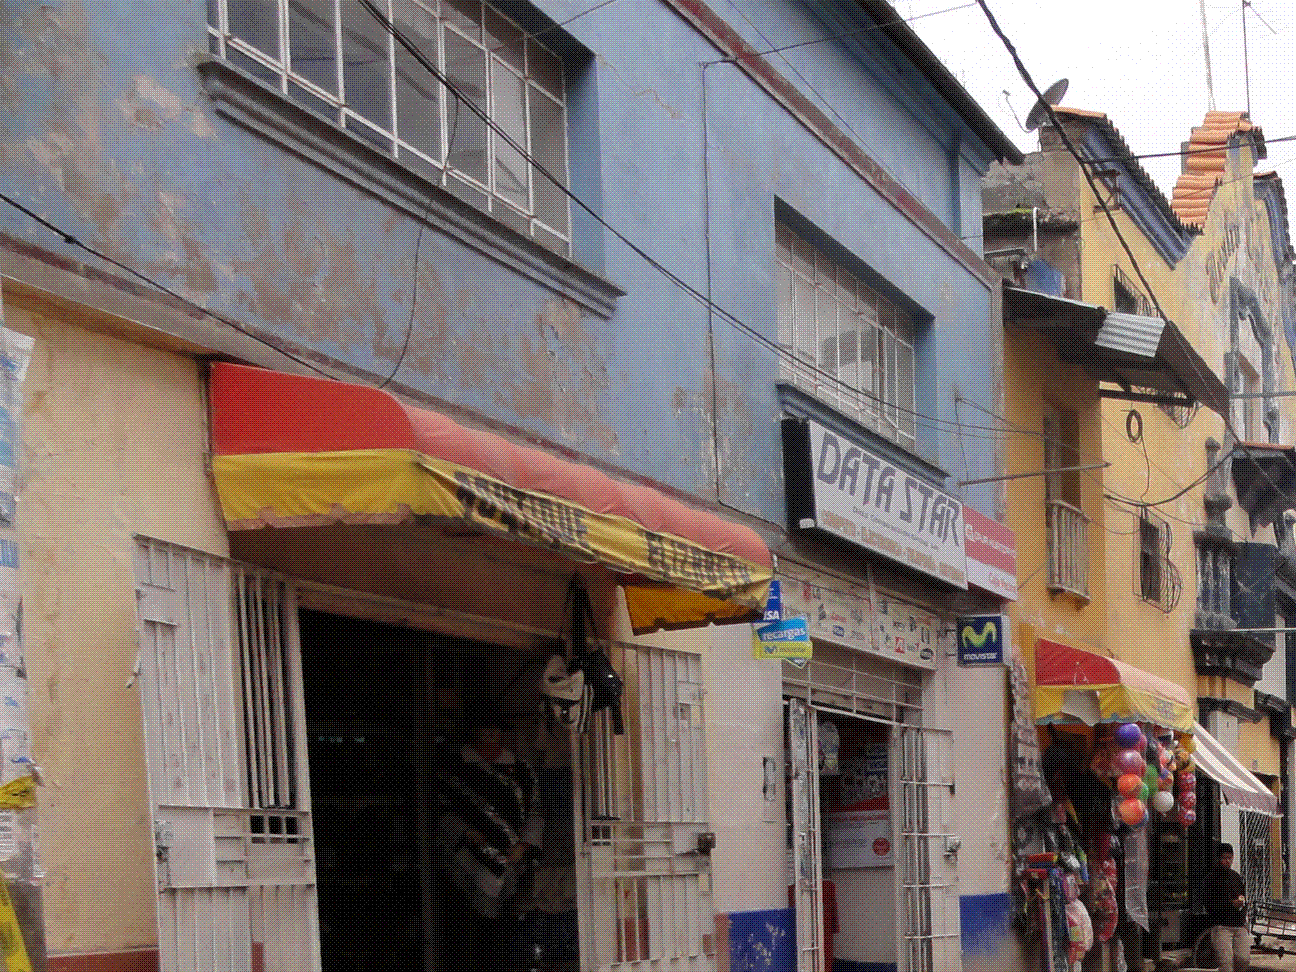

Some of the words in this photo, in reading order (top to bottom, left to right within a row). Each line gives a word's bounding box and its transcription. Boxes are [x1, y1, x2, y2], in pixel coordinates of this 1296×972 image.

[817, 431, 897, 513] DATA
[899, 477, 960, 547] STAR
[763, 610, 780, 620] ISA
[762, 628, 806, 640] recargas
[964, 652, 997, 660] movistar
